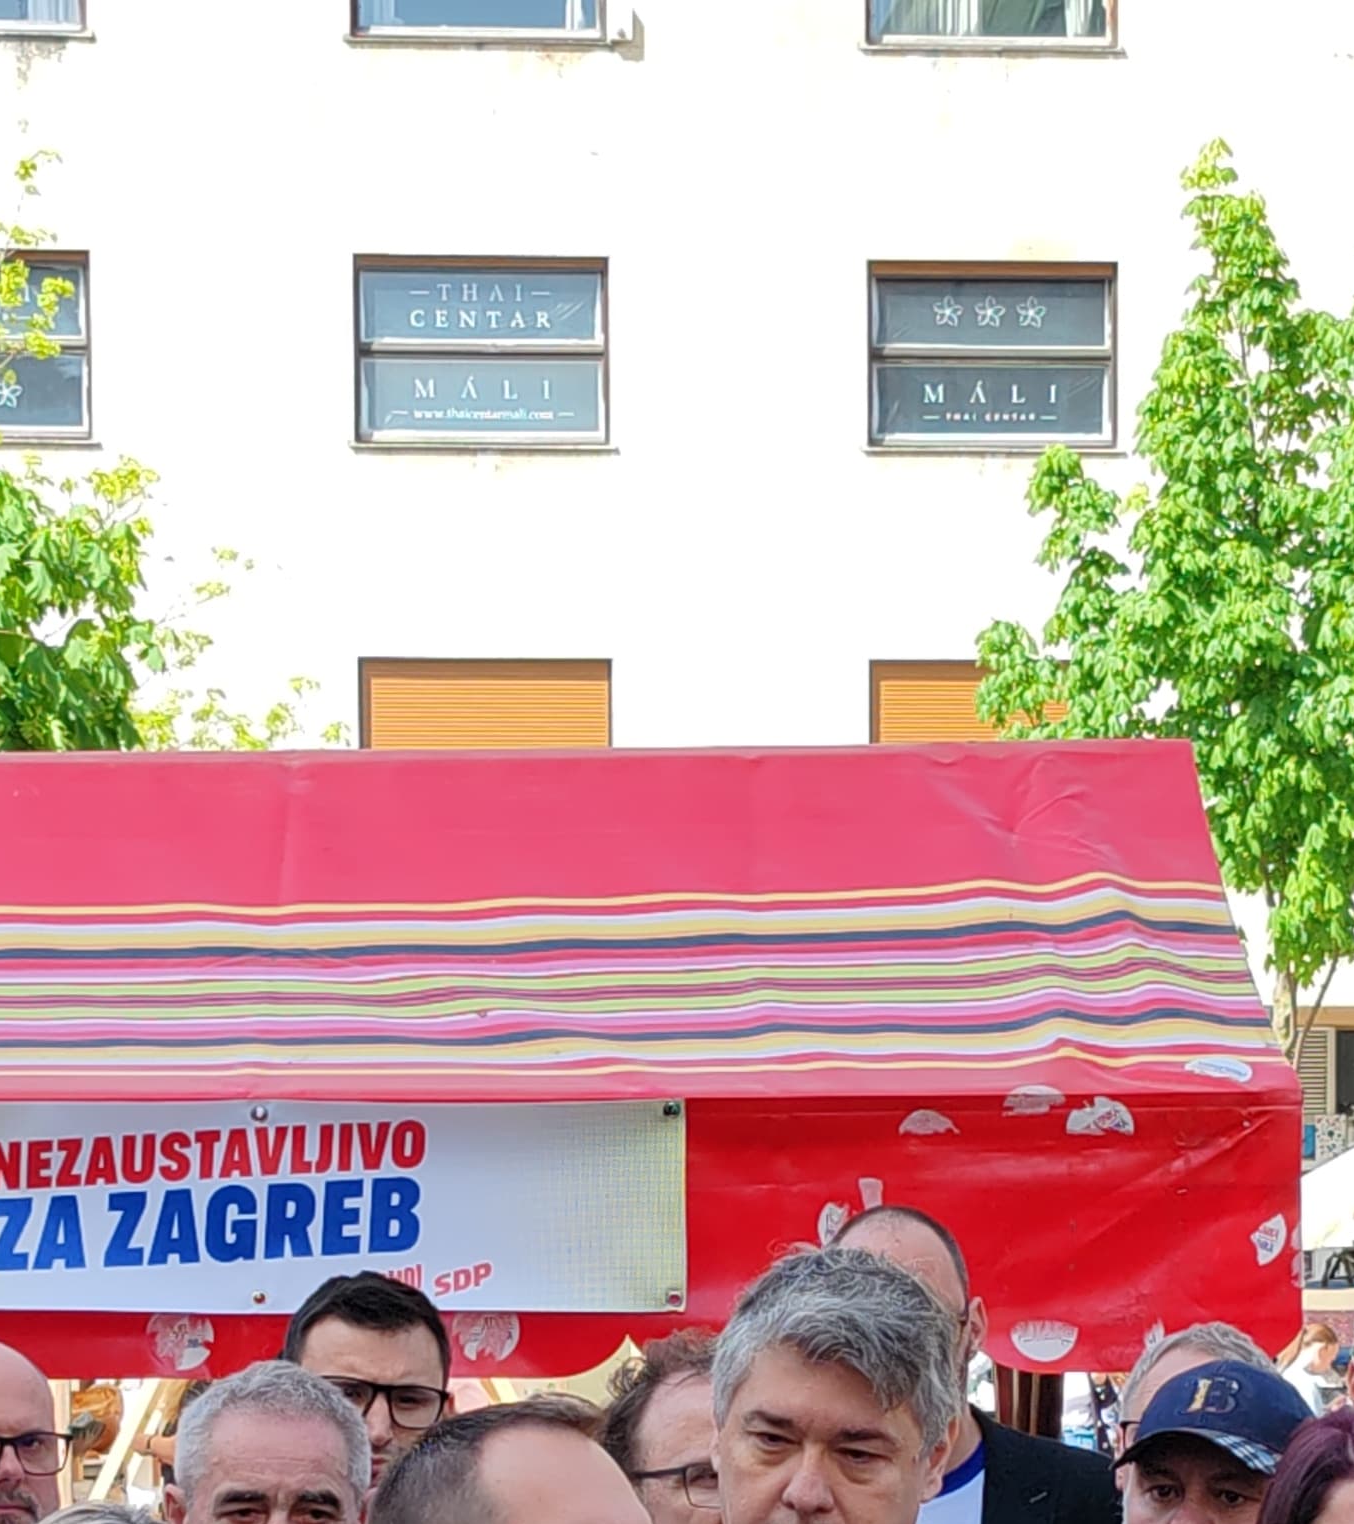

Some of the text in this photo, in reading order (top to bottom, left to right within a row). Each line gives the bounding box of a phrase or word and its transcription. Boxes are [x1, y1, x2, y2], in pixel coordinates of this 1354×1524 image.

[437, 283, 522, 302] THAI
[409, 309, 551, 328] CENTAR
[414, 376, 550, 400] MÁLI
[923, 380, 1057, 403] MÁLI
[103, 1176, 421, 1268] ZAGREB
[433, 1261, 493, 1297] SDP
